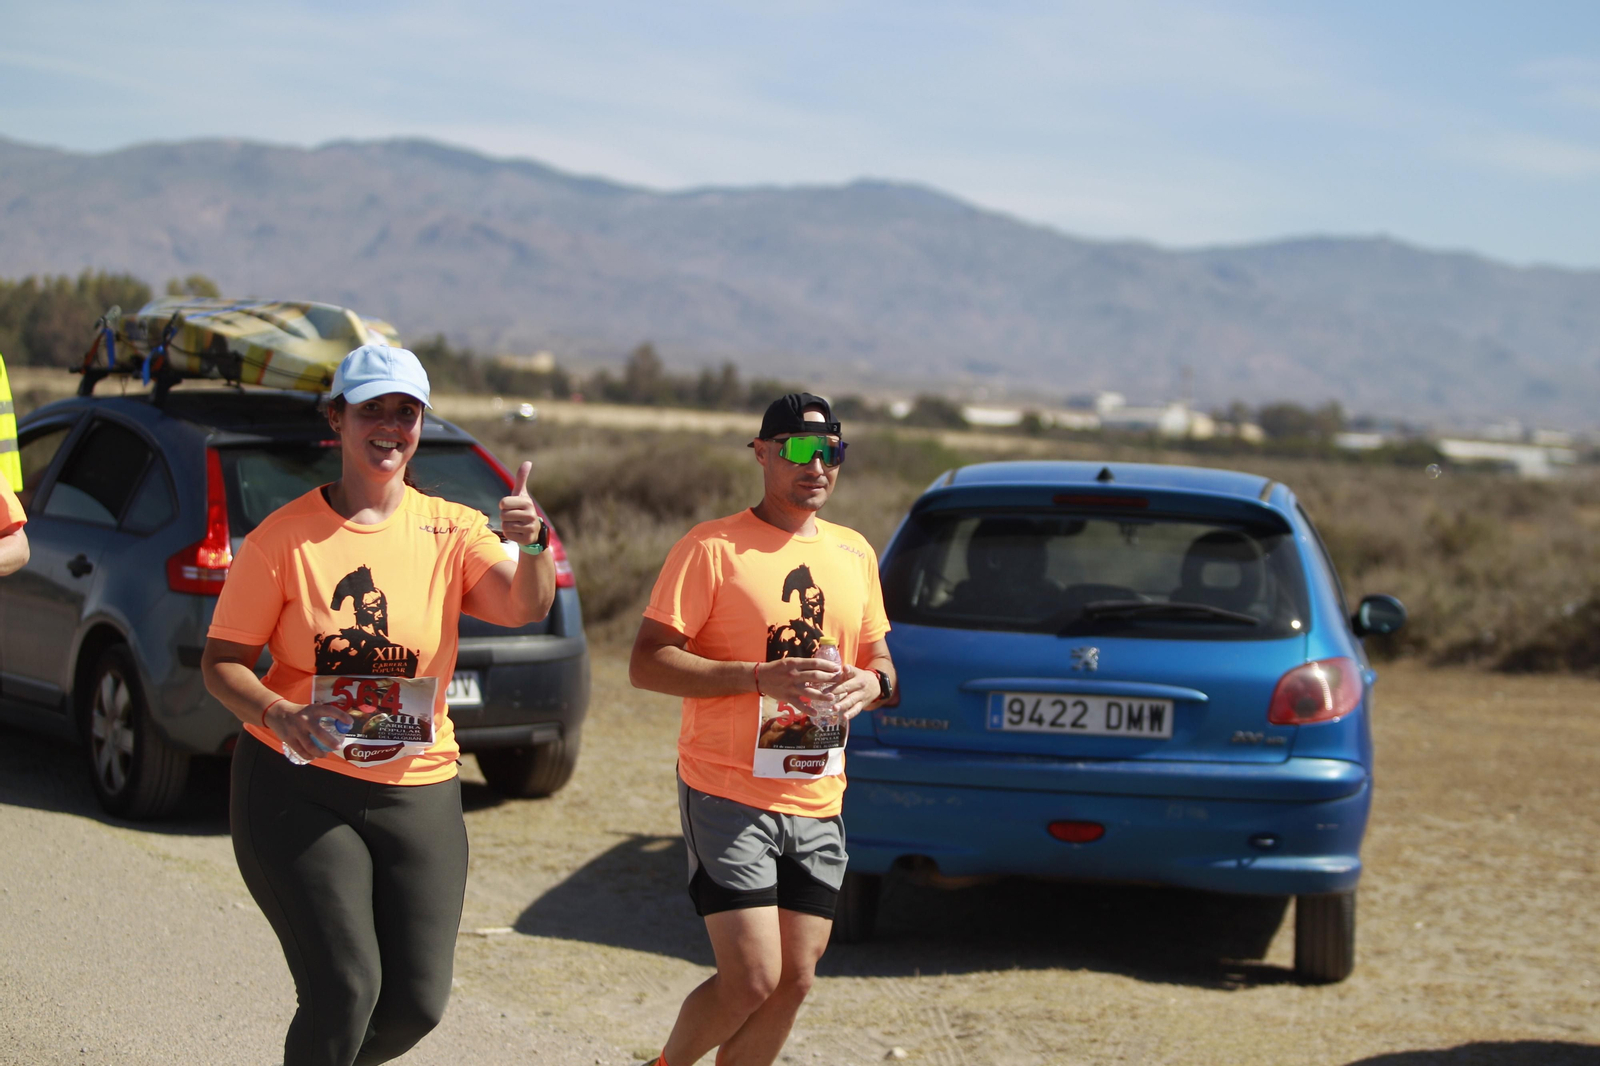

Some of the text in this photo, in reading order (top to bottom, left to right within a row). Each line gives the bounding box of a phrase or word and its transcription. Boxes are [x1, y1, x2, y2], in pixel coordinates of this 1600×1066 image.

[373, 646, 408, 661] XIII
[330, 677, 403, 716] 564
[379, 713, 421, 726] XIII
[1007, 697, 1166, 732] 9422 DMW
[379, 722, 421, 730] CARRERA
